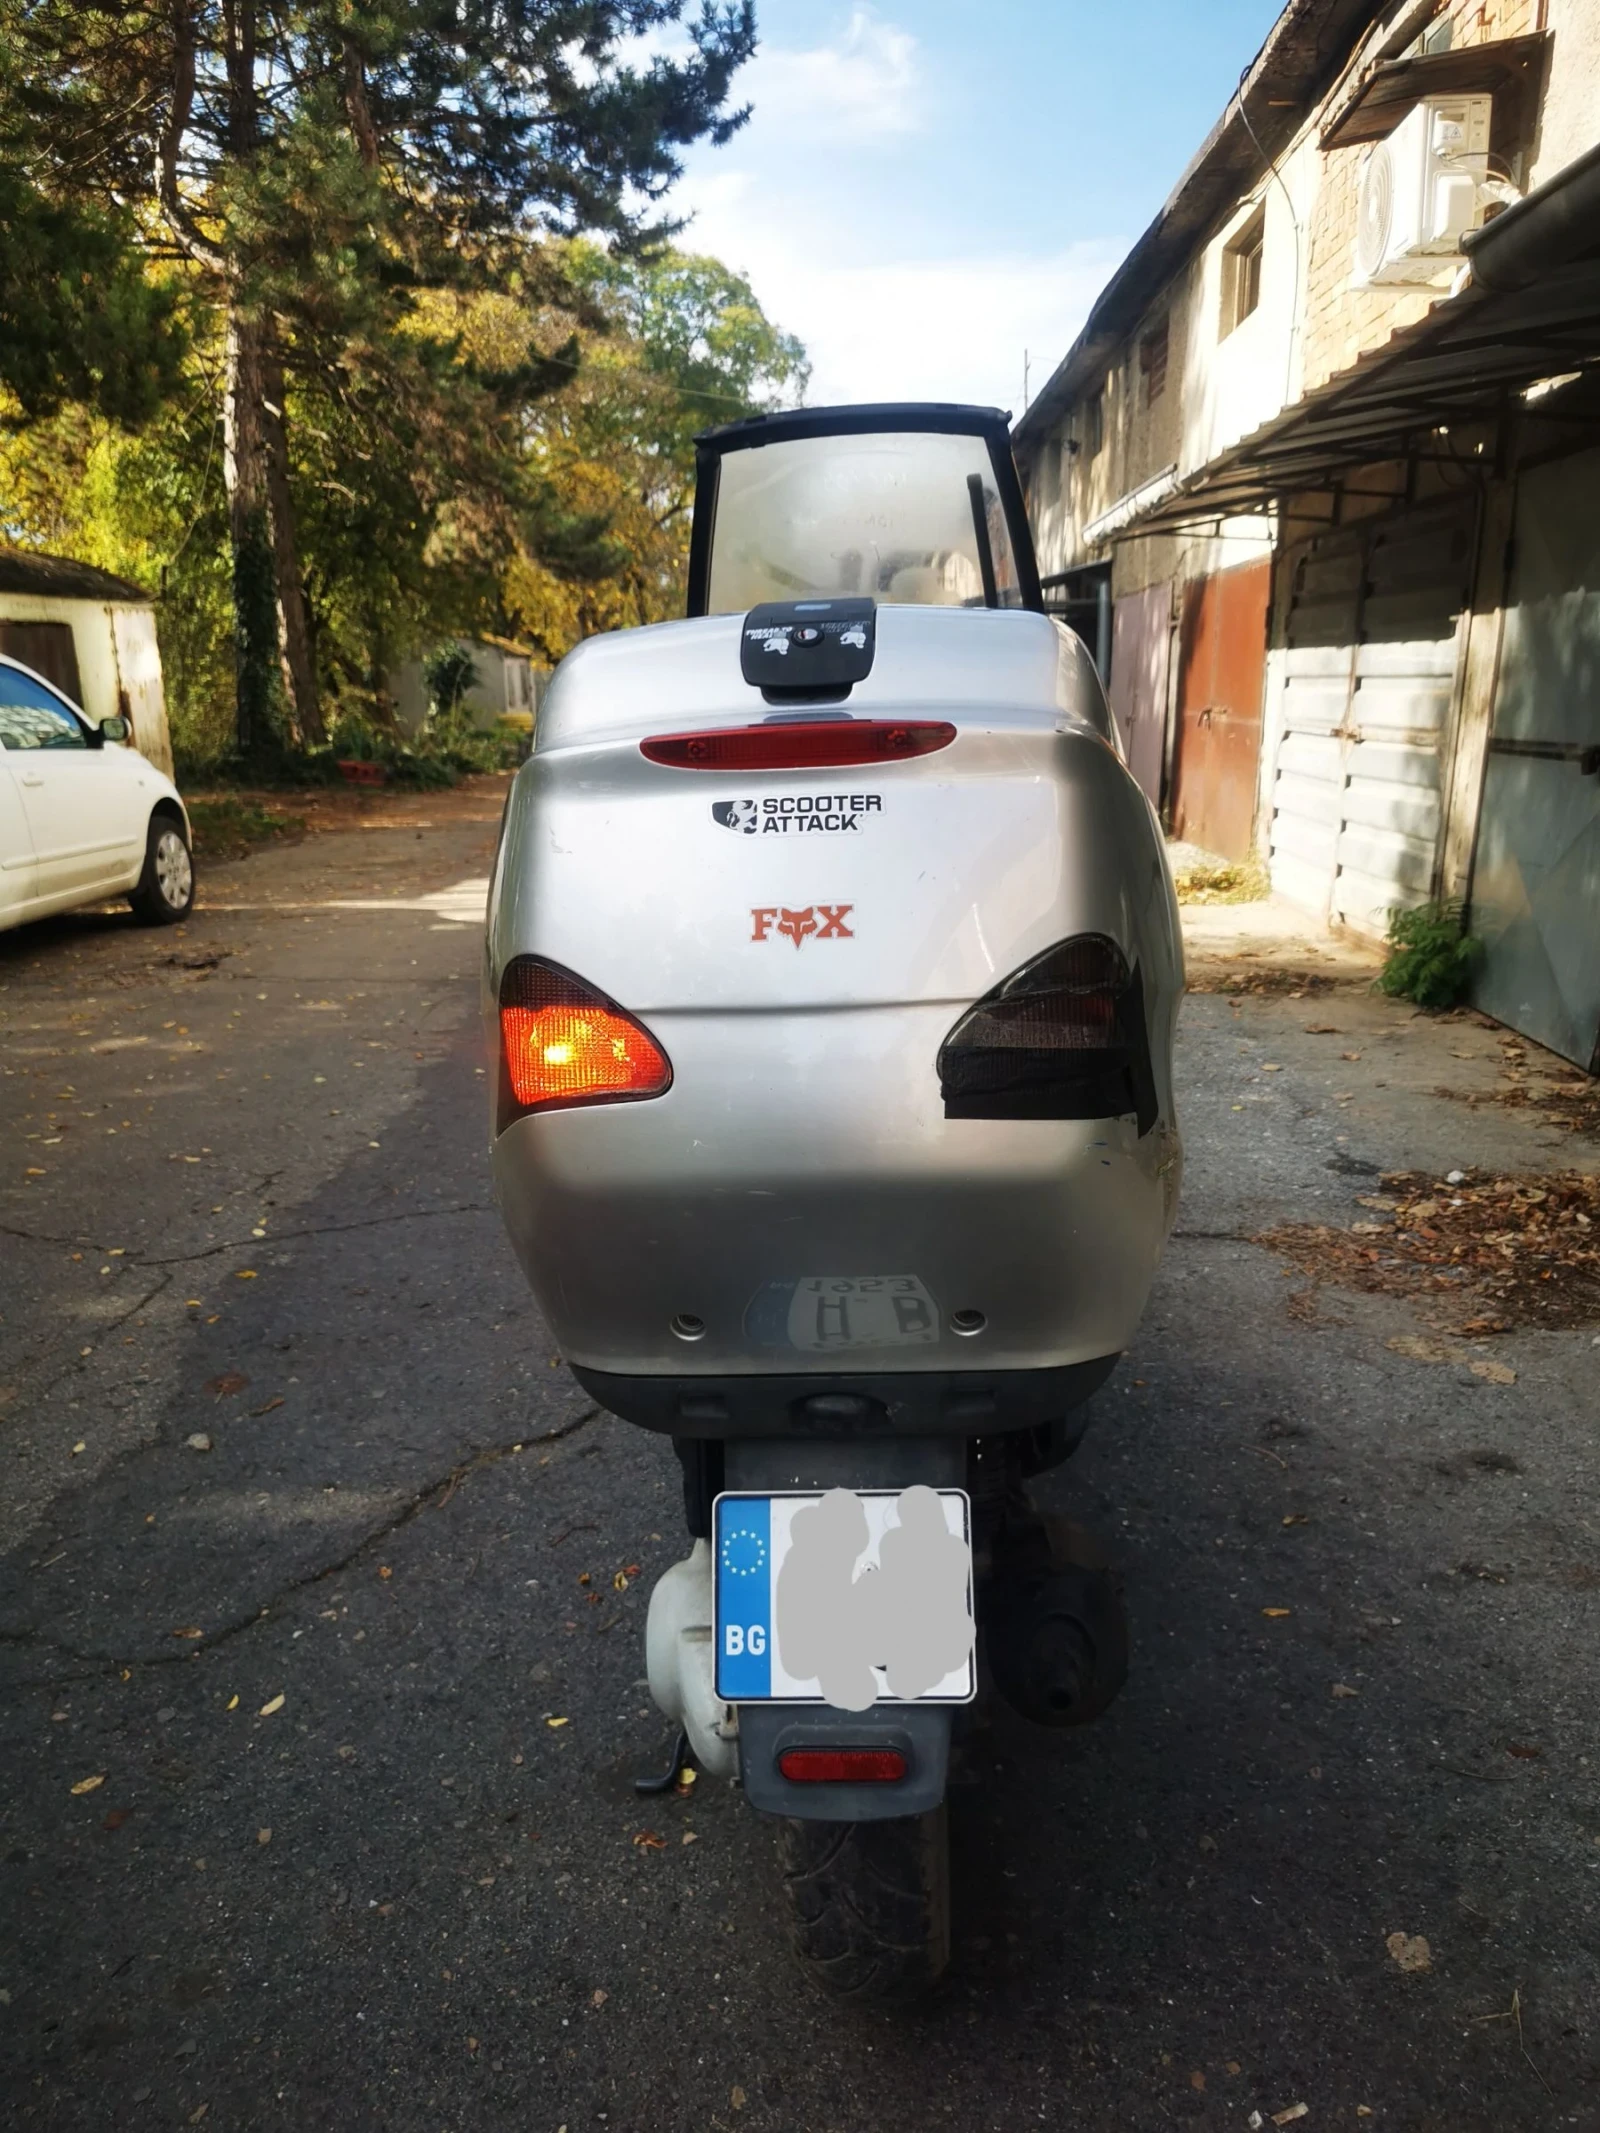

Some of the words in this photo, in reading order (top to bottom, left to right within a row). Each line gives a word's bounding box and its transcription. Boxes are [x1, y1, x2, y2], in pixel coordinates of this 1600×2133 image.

[762, 795, 882, 814] SCOOTER
[762, 814, 858, 833] ATTACK
[726, 1624, 766, 1655] BG
